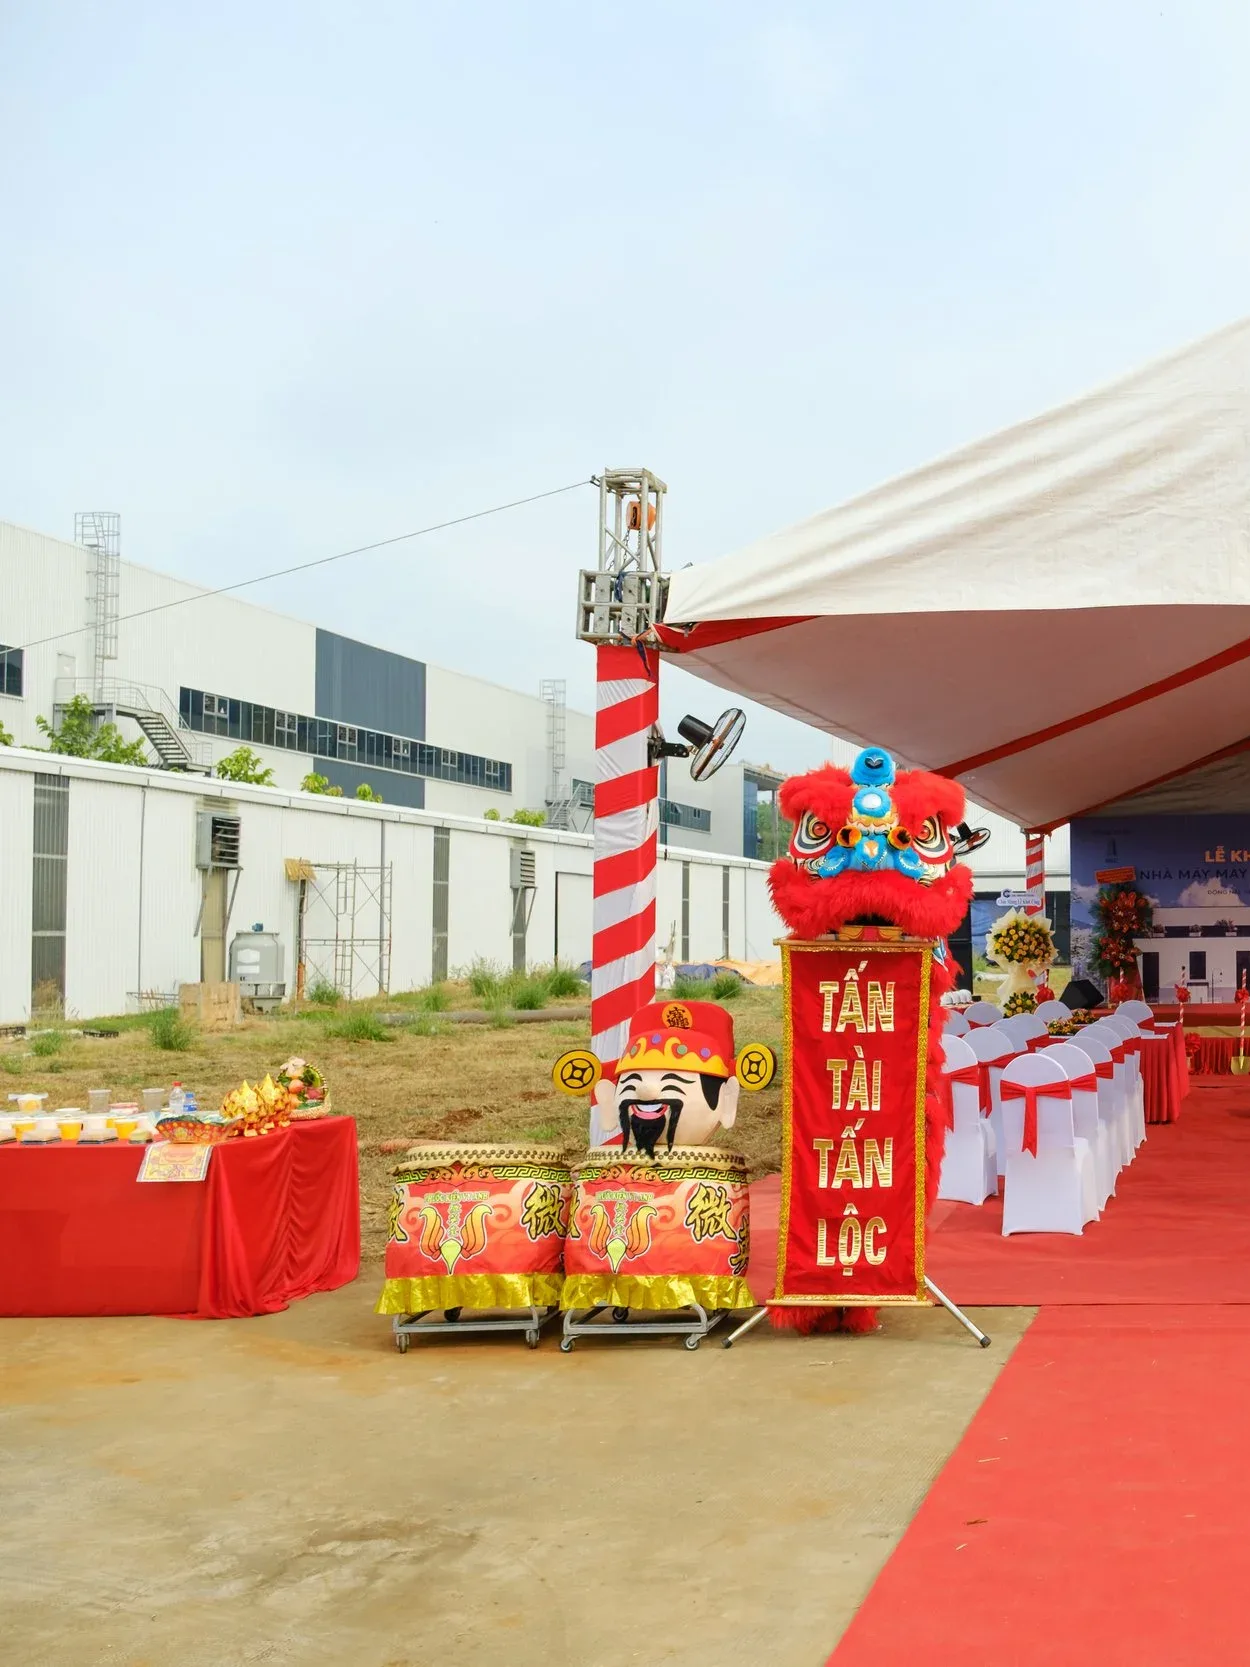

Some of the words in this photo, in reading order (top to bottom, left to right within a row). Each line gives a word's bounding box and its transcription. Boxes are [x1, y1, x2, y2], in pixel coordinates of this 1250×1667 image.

[1140, 866, 1173, 880] NHÀ
[1205, 845, 1226, 863] LỄ
[819, 960, 895, 1033] TẤN
[826, 1045, 882, 1111] TÀI
[813, 1118, 893, 1189] TẤN
[816, 1203, 887, 1276] LỘC
